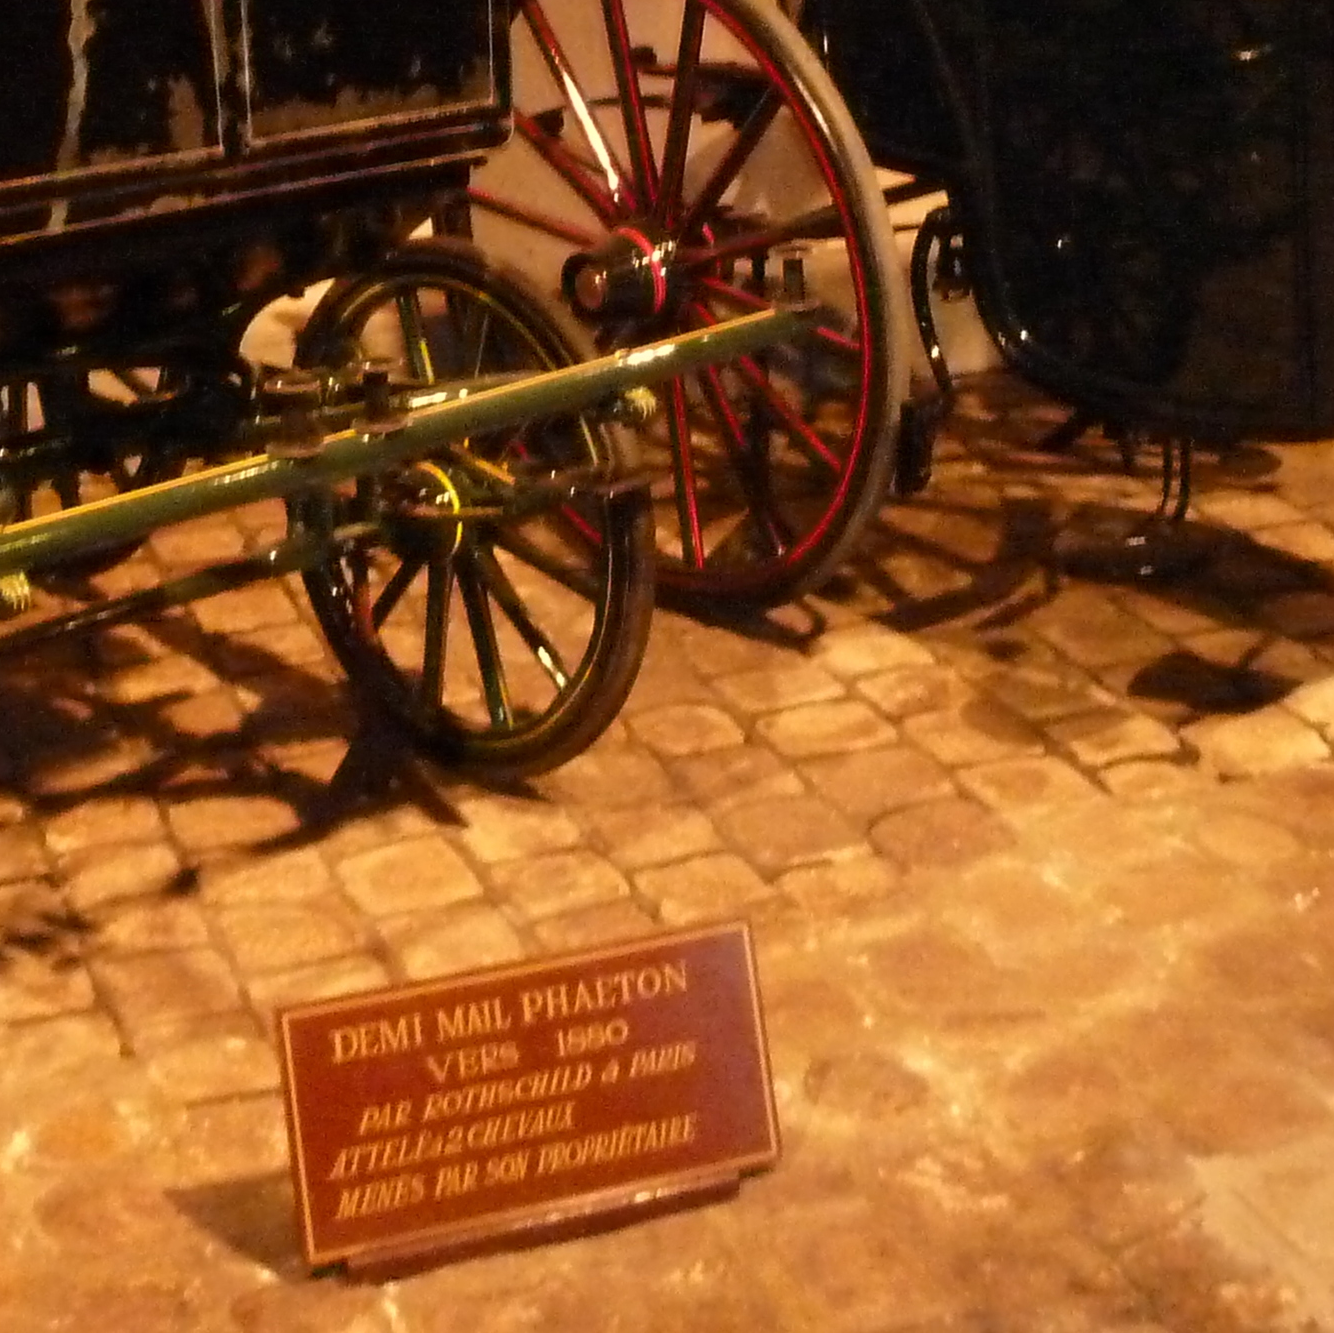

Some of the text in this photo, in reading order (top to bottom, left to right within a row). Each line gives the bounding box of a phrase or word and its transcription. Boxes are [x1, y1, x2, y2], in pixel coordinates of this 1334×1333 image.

[329, 1012, 422, 1064] DEMI
[437, 996, 512, 1042] MAIL
[427, 1040, 519, 1084] VERS
[358, 1099, 412, 1136] PAR
[467, 1101, 576, 1148] CHEVAUX
[435, 1160, 479, 1201] PAR
[484, 1149, 530, 1187] SON
